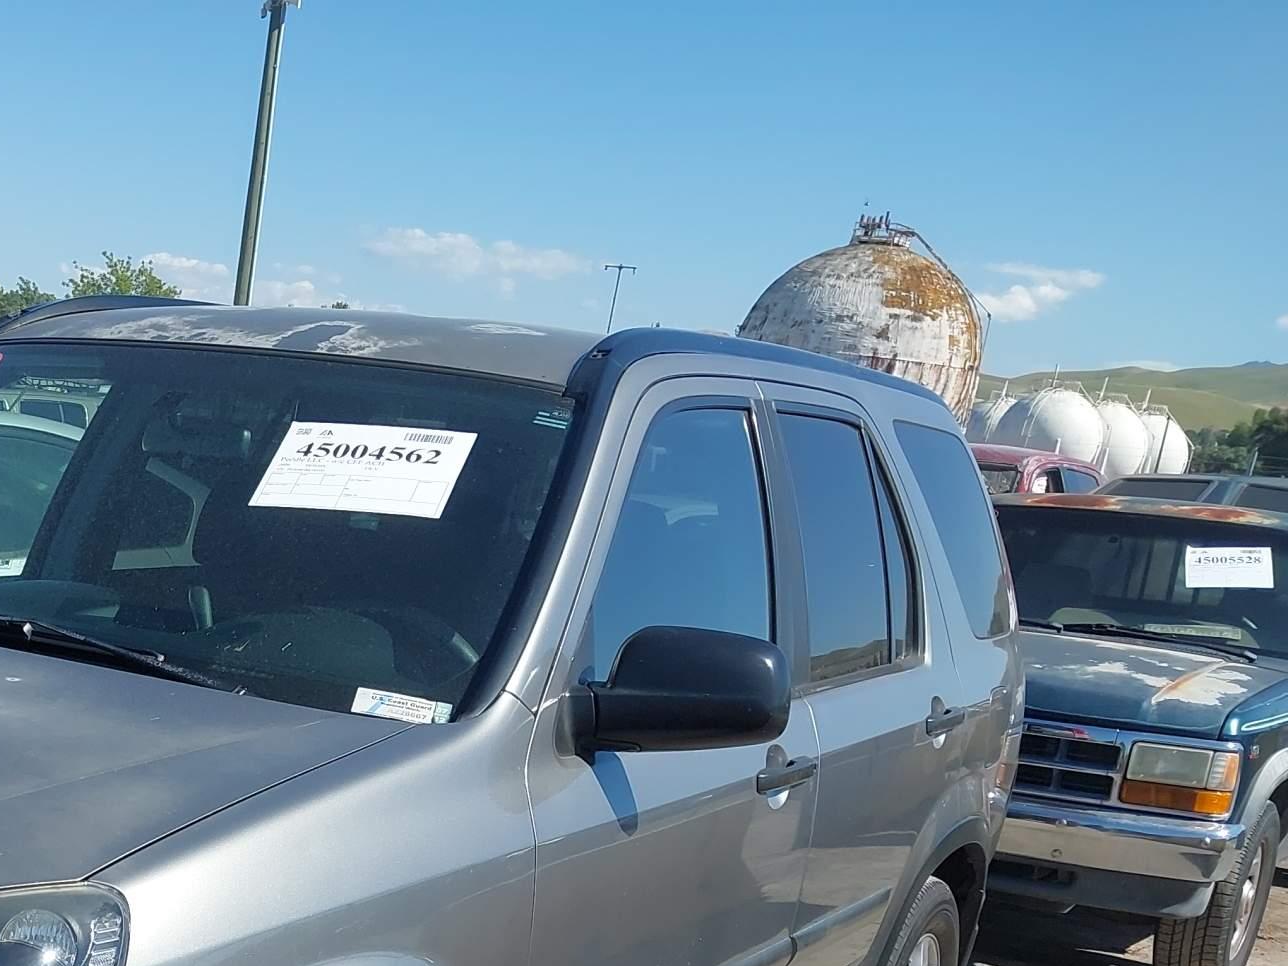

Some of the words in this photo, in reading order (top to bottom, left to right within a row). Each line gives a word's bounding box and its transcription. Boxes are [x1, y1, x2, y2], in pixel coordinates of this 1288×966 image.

[296, 441, 443, 465] 45004562
[1193, 556, 1263, 565] 45005528
[409, 702, 433, 711] Guard
